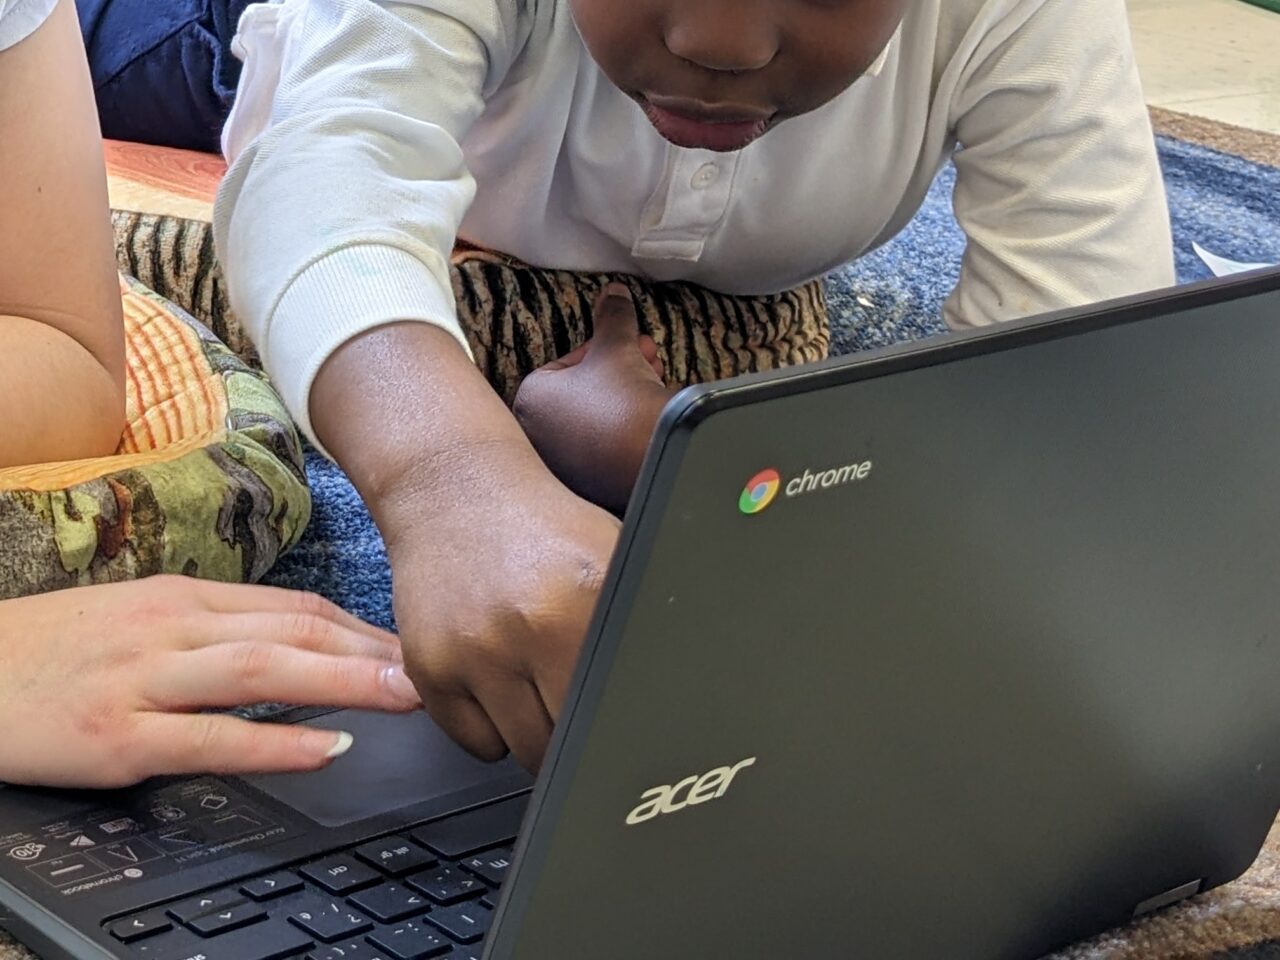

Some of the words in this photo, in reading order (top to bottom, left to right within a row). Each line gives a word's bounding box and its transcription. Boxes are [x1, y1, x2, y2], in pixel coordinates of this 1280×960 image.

[785, 458, 872, 498] chrome
[625, 756, 756, 825] acer
[61, 873, 124, 896] chromebook
[328, 865, 349, 877] ctrl
